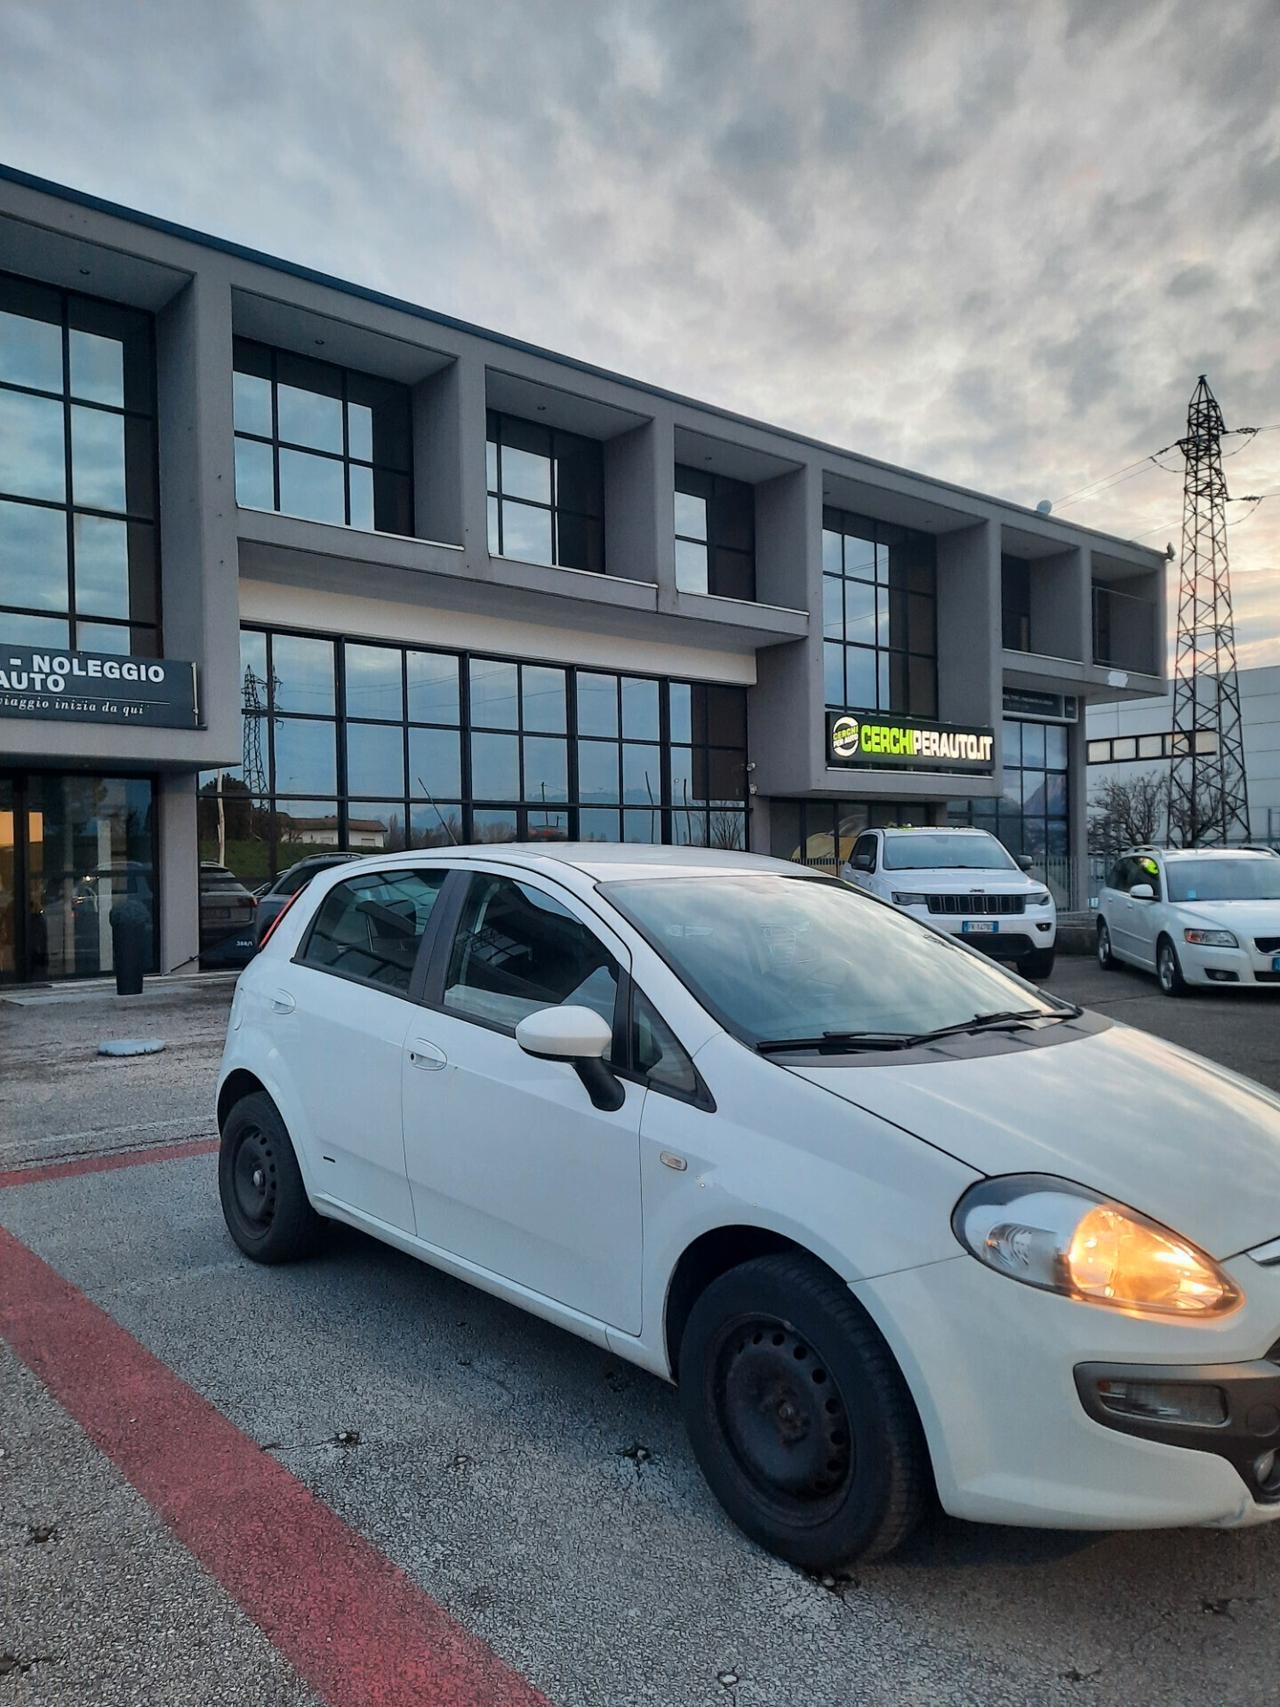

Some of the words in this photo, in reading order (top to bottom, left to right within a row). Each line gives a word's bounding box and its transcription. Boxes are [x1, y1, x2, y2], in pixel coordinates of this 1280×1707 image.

[32, 654, 165, 683] NOLEGGIO
[0, 669, 66, 693] AUTO
[55, 697, 97, 713] inizia
[101, 702, 118, 714] da
[122, 703, 145, 718] qui
[833, 724, 859, 741] CERCHI
[860, 724, 994, 761] CERCHIPERAUTO.IT
